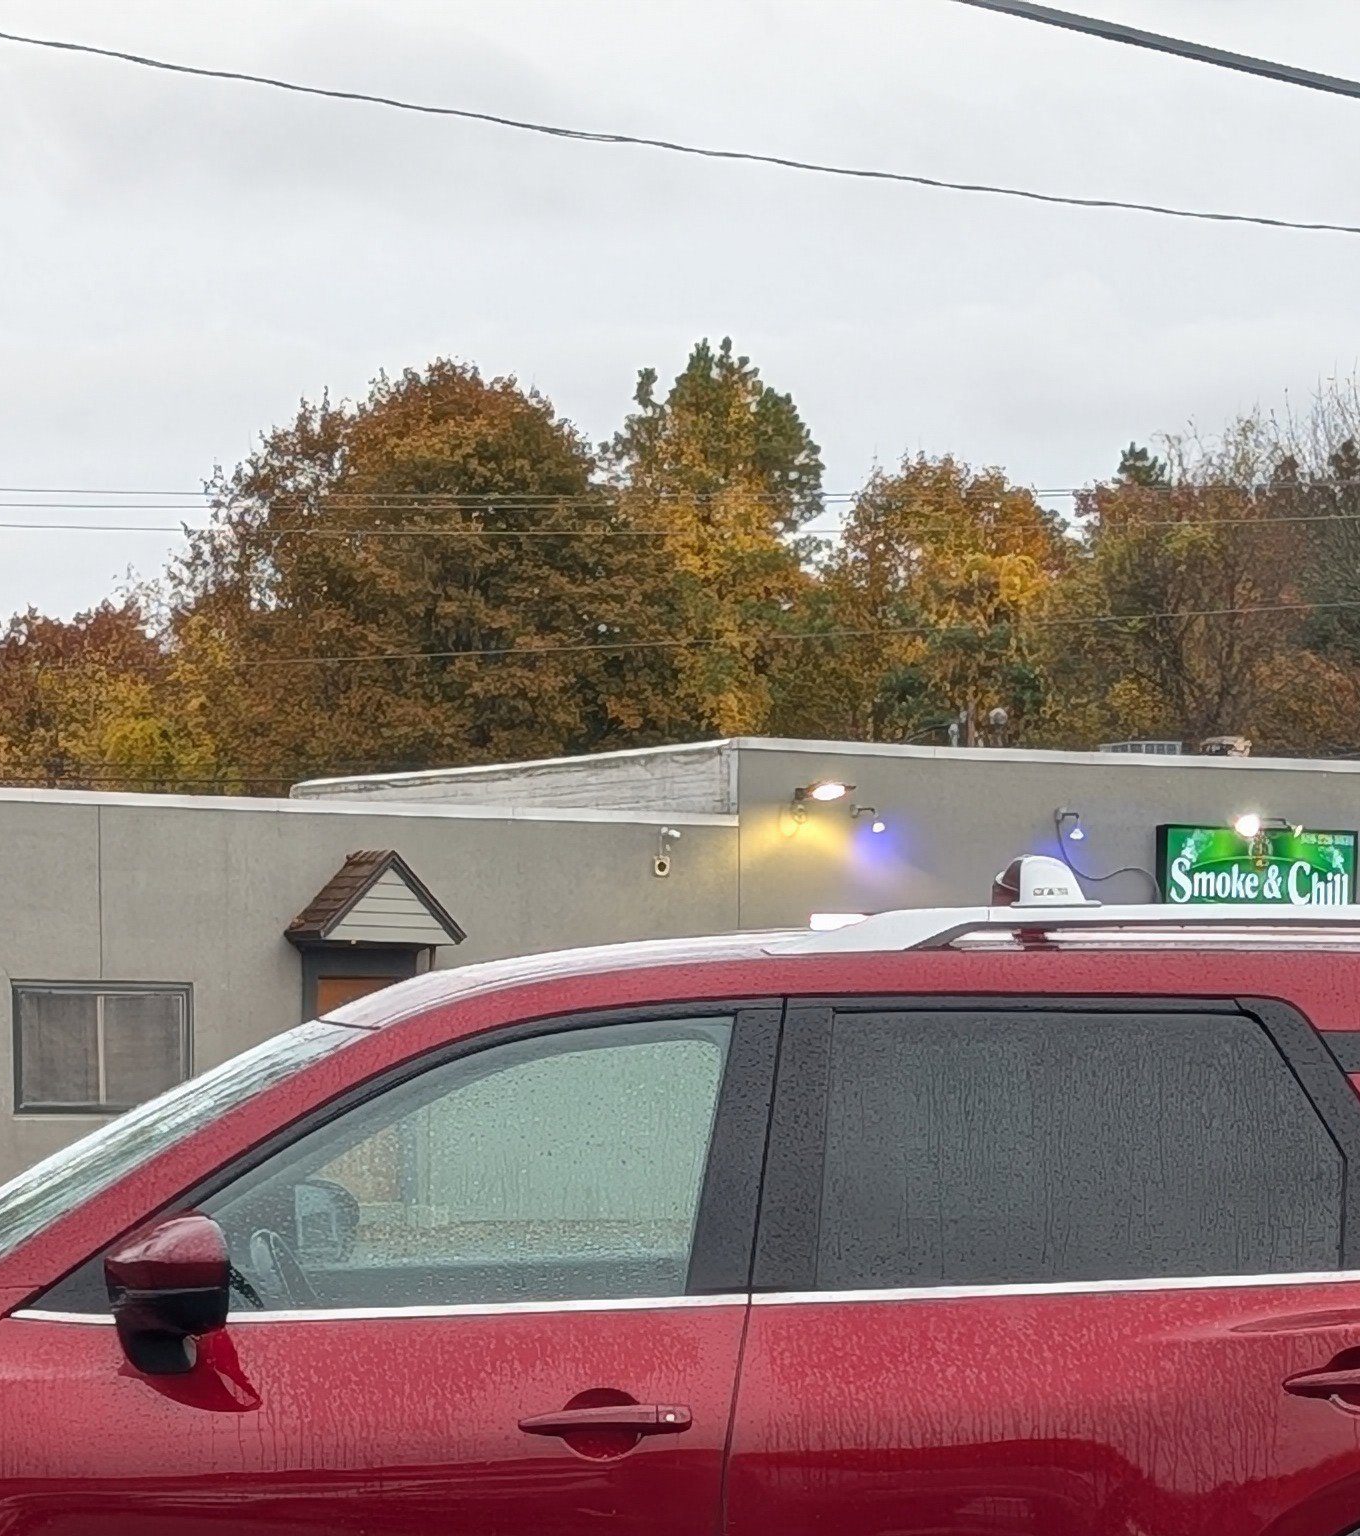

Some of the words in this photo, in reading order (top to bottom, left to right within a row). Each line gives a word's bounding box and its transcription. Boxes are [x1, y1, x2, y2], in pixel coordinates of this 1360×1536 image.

[1170, 857, 1259, 903] Smoke
[1263, 864, 1283, 899] &
[1288, 860, 1349, 906] Chill
